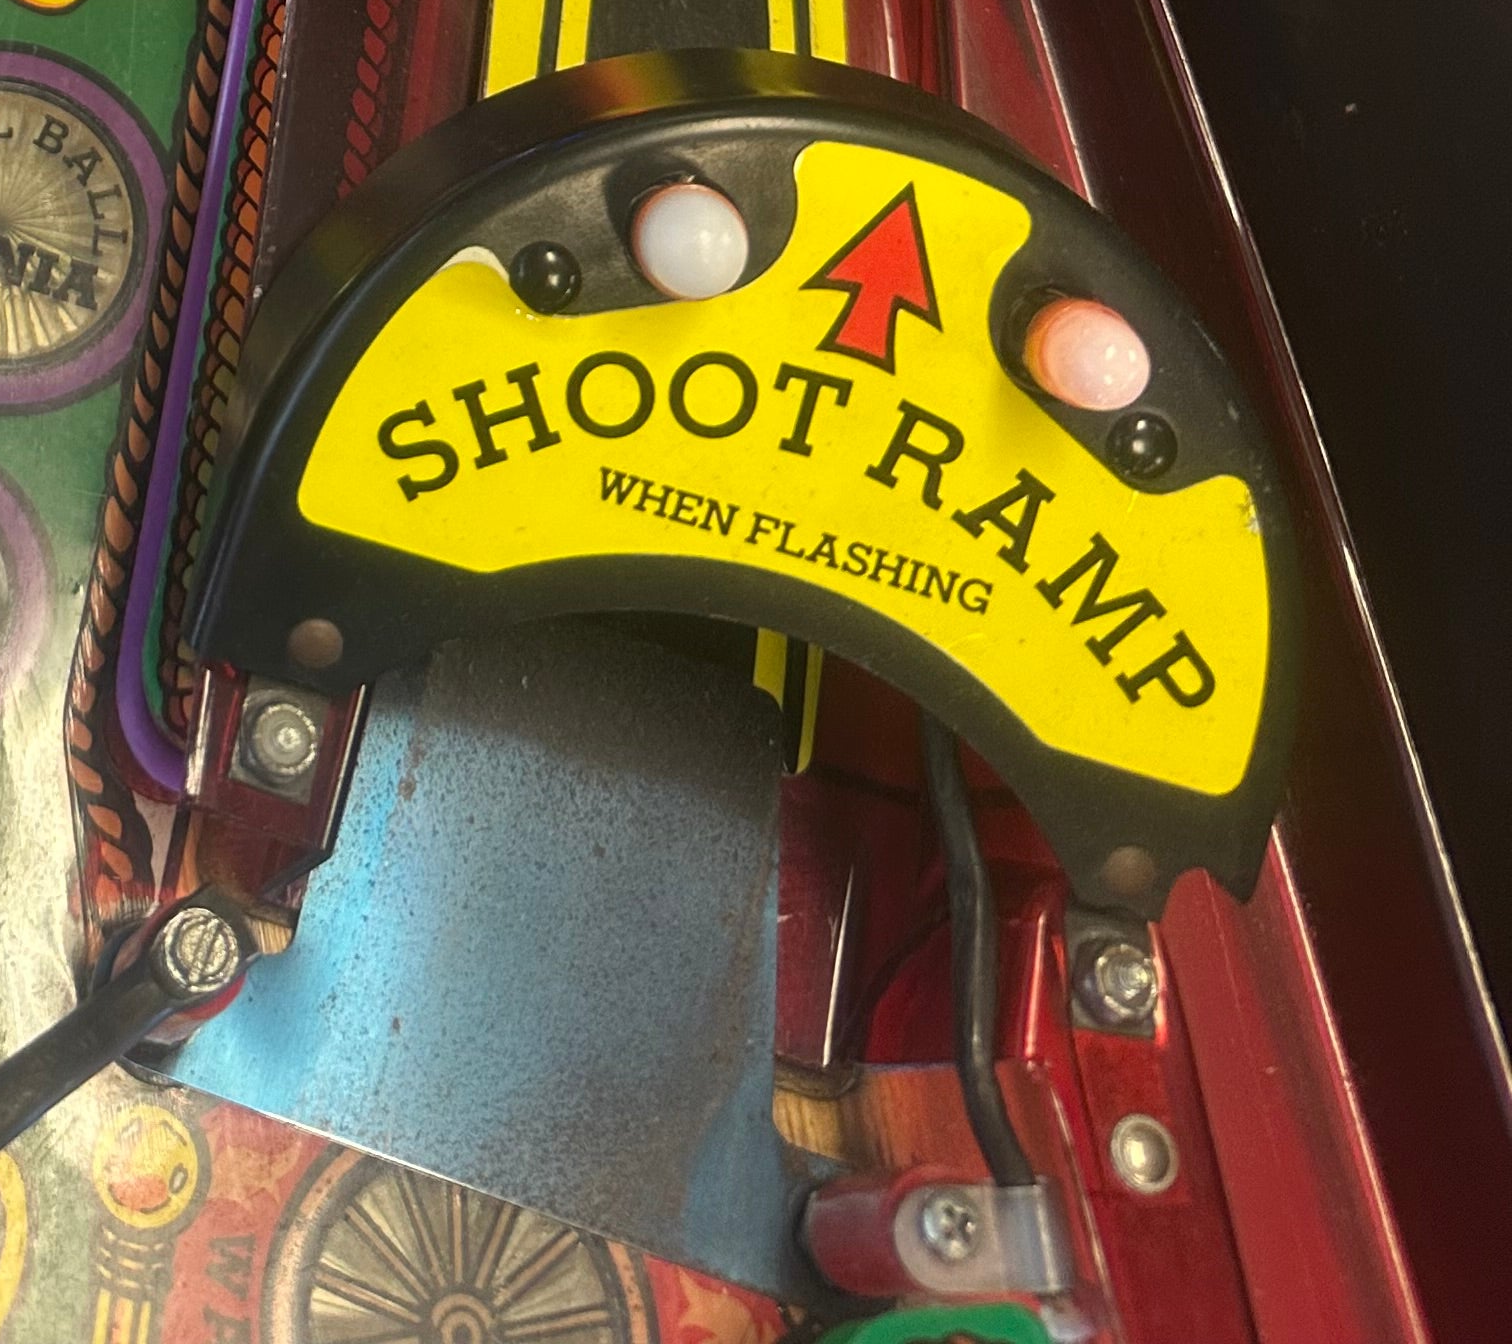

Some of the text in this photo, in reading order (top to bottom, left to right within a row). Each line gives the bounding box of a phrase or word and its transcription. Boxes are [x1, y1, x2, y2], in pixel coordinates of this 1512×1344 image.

[33, 115, 128, 257] BALL
[376, 350, 1218, 711] SHOOT RAMP
[598, 466, 994, 615] WHEN FLASHING
